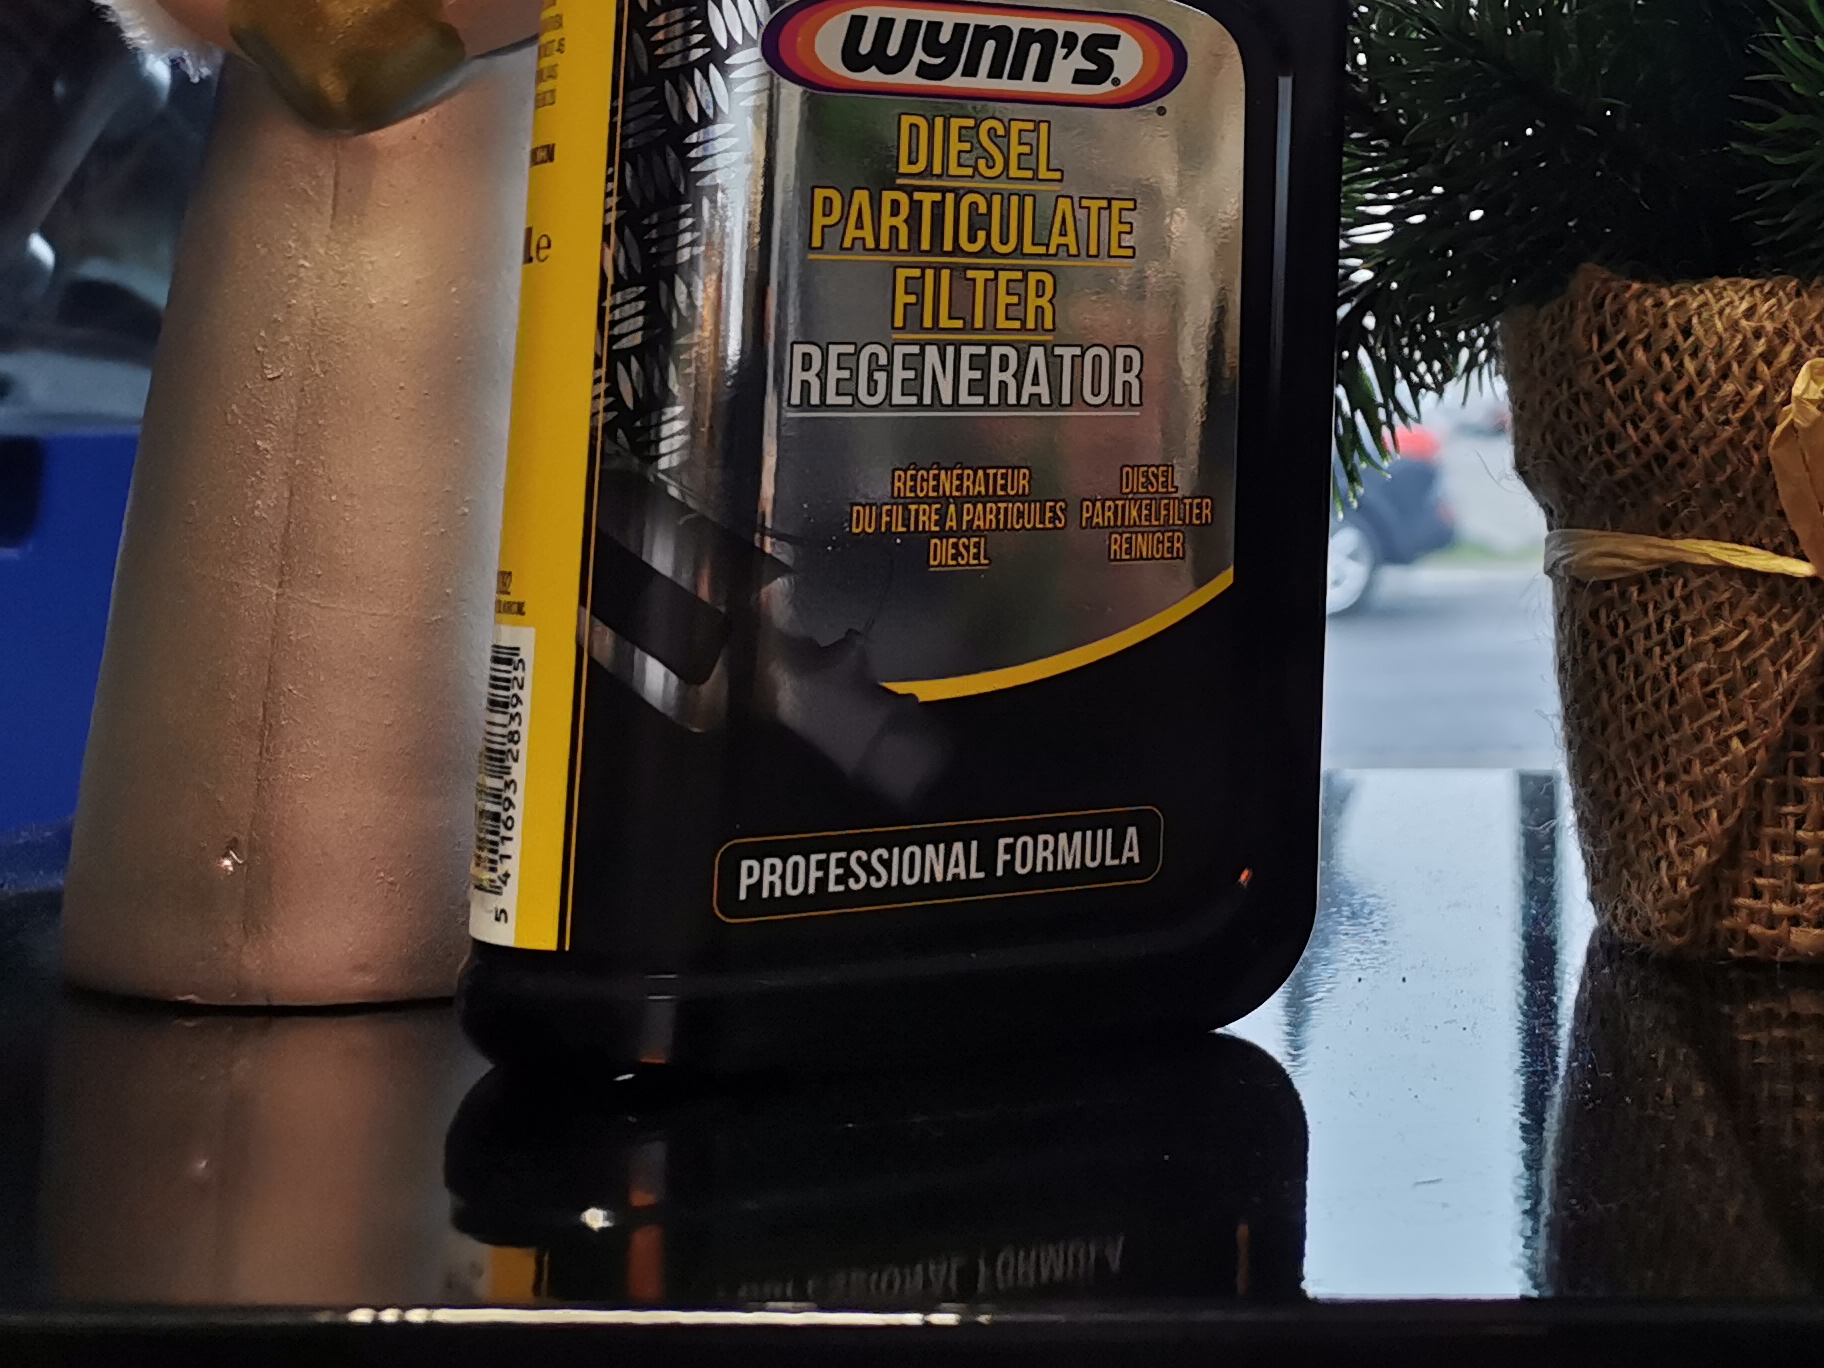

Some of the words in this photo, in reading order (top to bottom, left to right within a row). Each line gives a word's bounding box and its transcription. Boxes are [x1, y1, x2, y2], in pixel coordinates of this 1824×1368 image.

[897, 113, 1063, 182] DIESEL
[809, 186, 1137, 260] PARTICULATE
[892, 267, 1057, 331] FILTER
[788, 342, 1144, 409] REGENERATOR
[1120, 465, 1178, 494] DIESEL
[851, 504, 877, 534] DU
[880, 501, 942, 533] FILTRE
[961, 499, 1067, 531] PARTICULES
[1081, 497, 1213, 529] PARTIKELFILTER
[928, 536, 991, 567] DIESEL
[1109, 531, 1185, 562] REINIGER
[738, 840, 985, 902] PROFESSIONAL
[996, 825, 1141, 877] FORMULA
